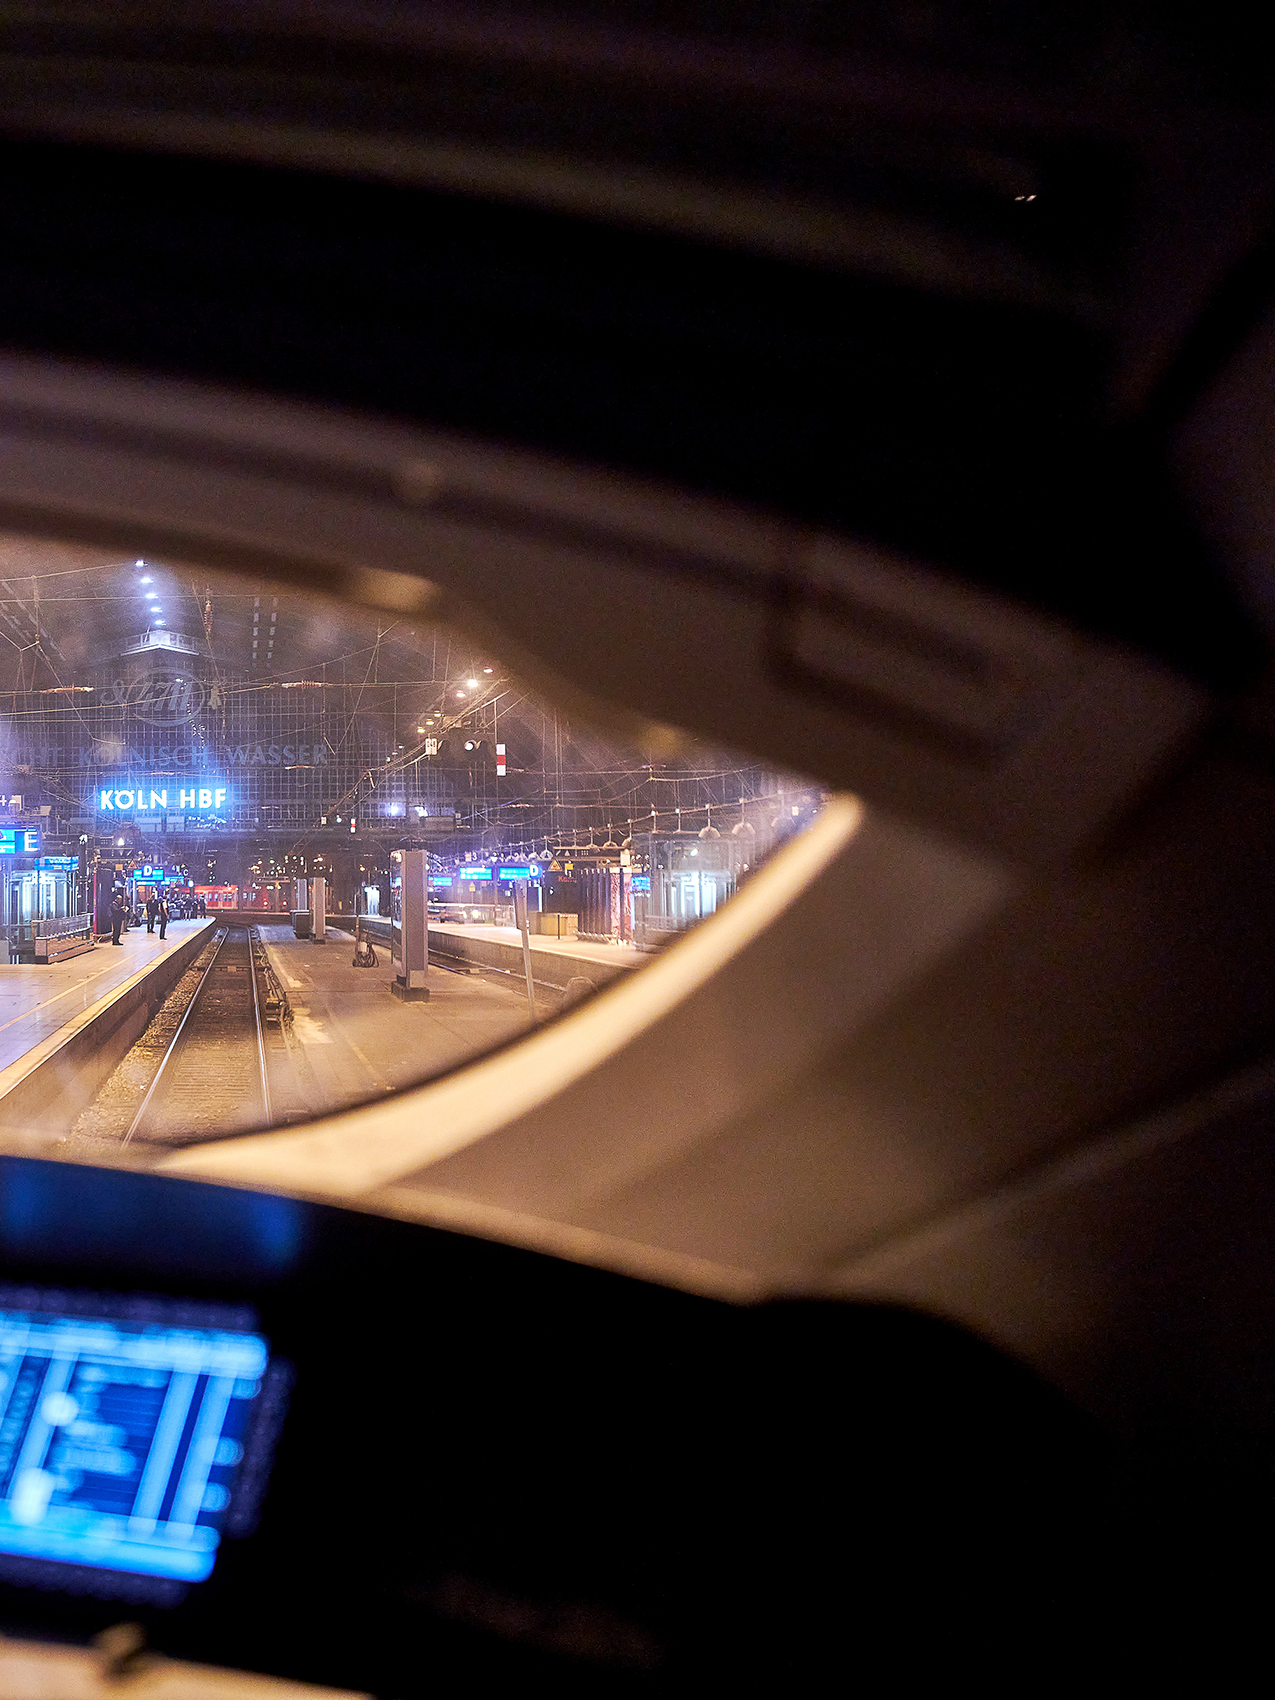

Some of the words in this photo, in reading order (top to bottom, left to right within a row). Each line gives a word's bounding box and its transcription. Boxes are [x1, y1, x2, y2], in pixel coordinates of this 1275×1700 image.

[225, 744, 327, 766] WASSER
[100, 787, 167, 810] KÖLN
[179, 787, 227, 809] HBF
[24, 830, 39, 852] E
[143, 865, 153, 876] D
[529, 865, 539, 877] D
